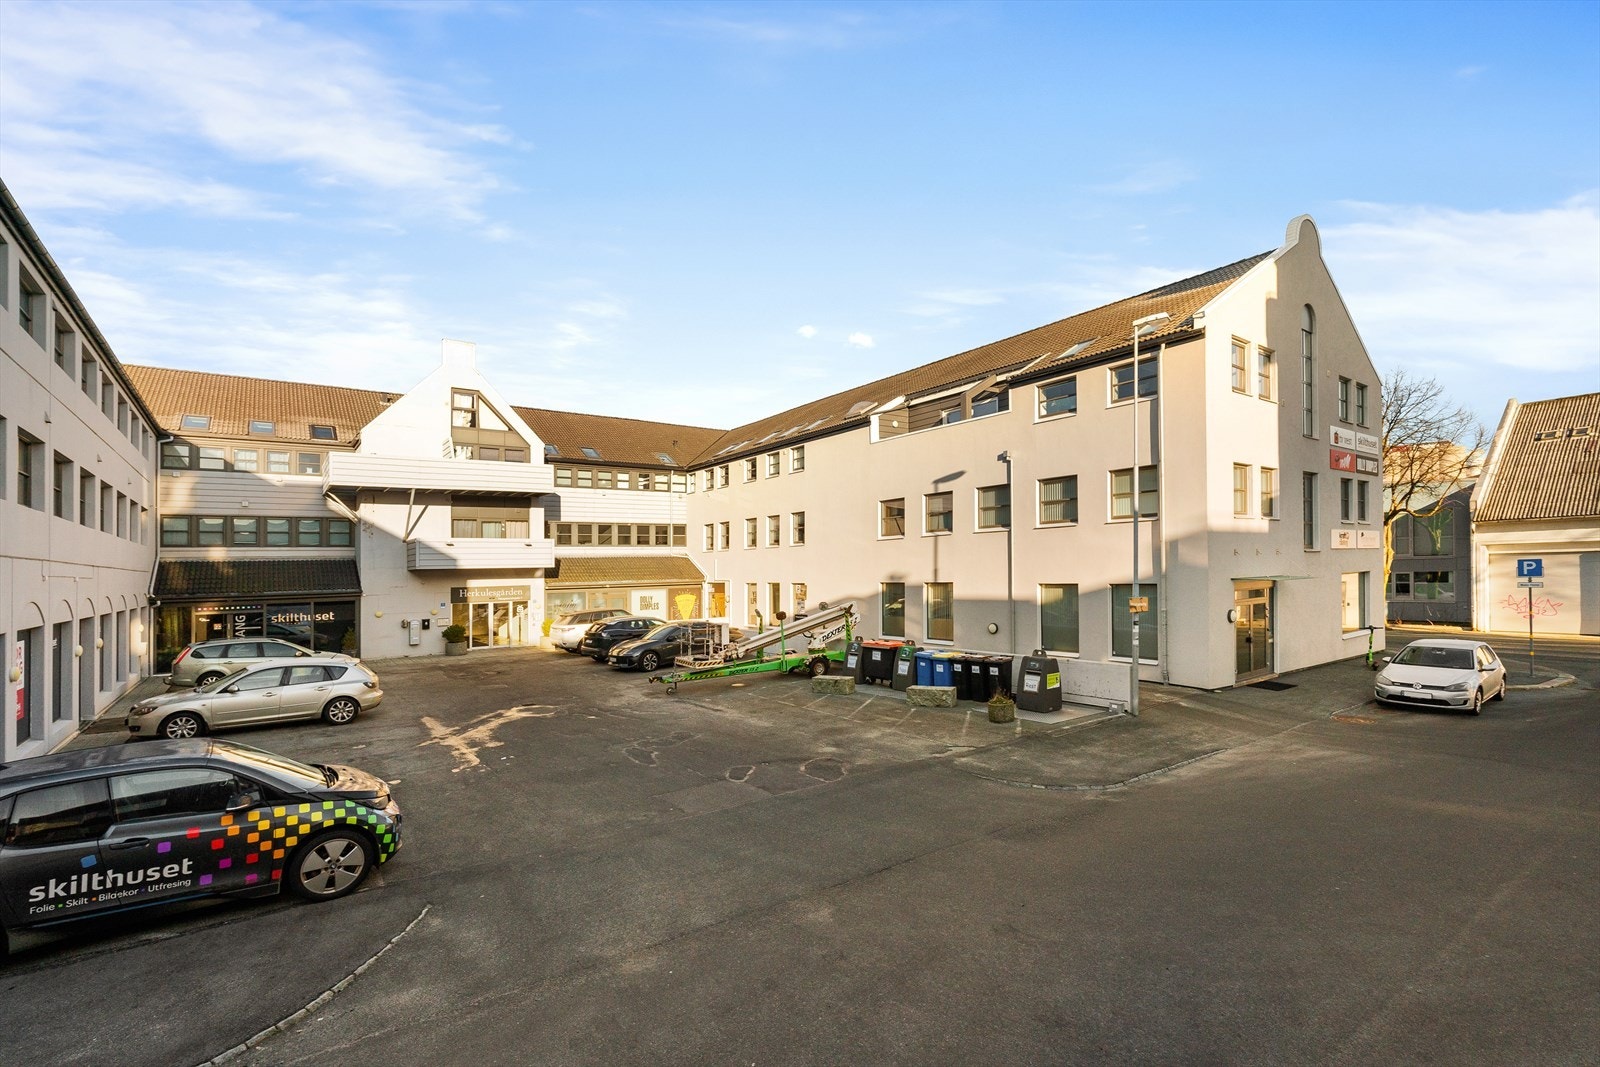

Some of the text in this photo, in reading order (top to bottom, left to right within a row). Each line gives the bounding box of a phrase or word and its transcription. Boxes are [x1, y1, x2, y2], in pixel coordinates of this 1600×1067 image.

[1523, 561, 1537, 575] P
[459, 587, 523, 598] Herkulesgården
[271, 611, 335, 623] skilthuset
[235, 615, 246, 639] ANG
[821, 624, 846, 642] DEXTER
[28, 858, 193, 902] skilthuset
[29, 904, 56, 915] Folie
[65, 897, 89, 908] Skilt
[147, 879, 191, 893] Utfresing
